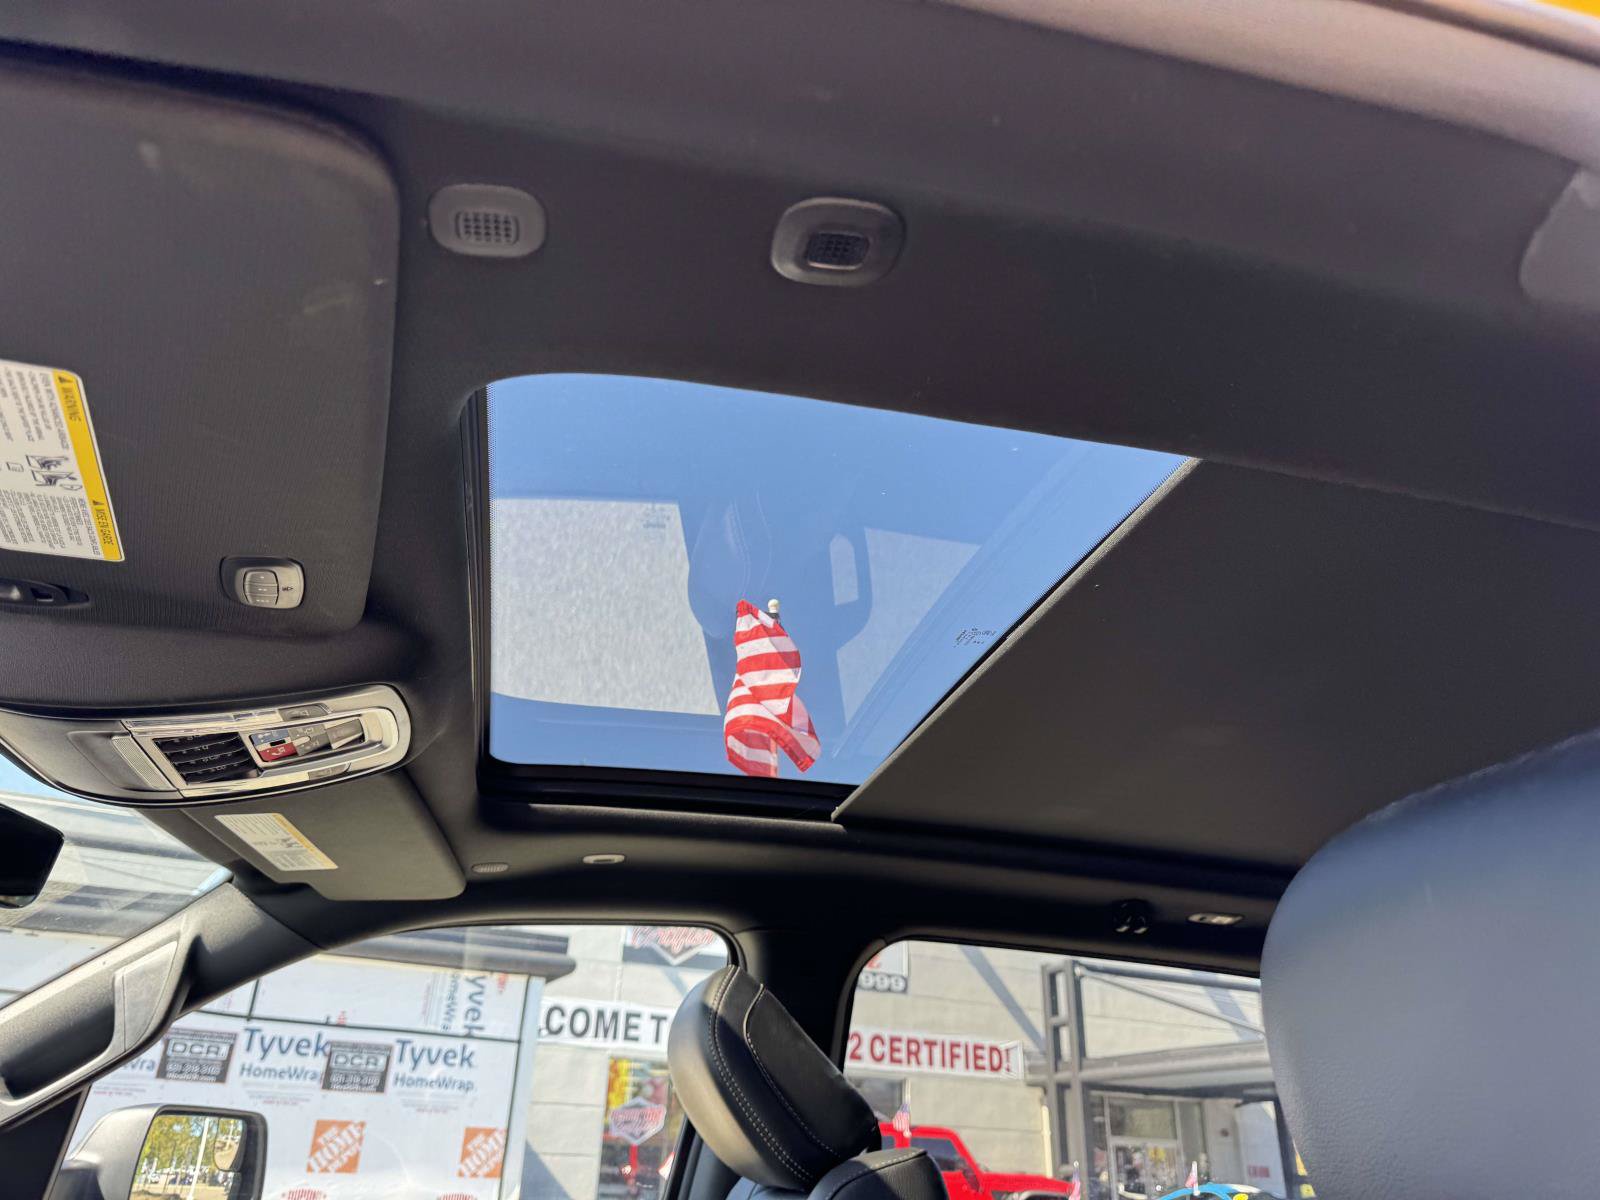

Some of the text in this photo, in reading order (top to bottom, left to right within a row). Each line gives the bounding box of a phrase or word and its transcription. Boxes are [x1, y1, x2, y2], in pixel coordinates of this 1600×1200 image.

[463, 974, 487, 1038] yvek
[244, 1026, 330, 1062] Tyvek
[395, 1037, 476, 1072] Tyvek
[869, 1033, 1012, 1073] CERTIFIED!
[239, 1062, 320, 1082] HomeWra
[393, 1071, 475, 1093] HomeWrap
